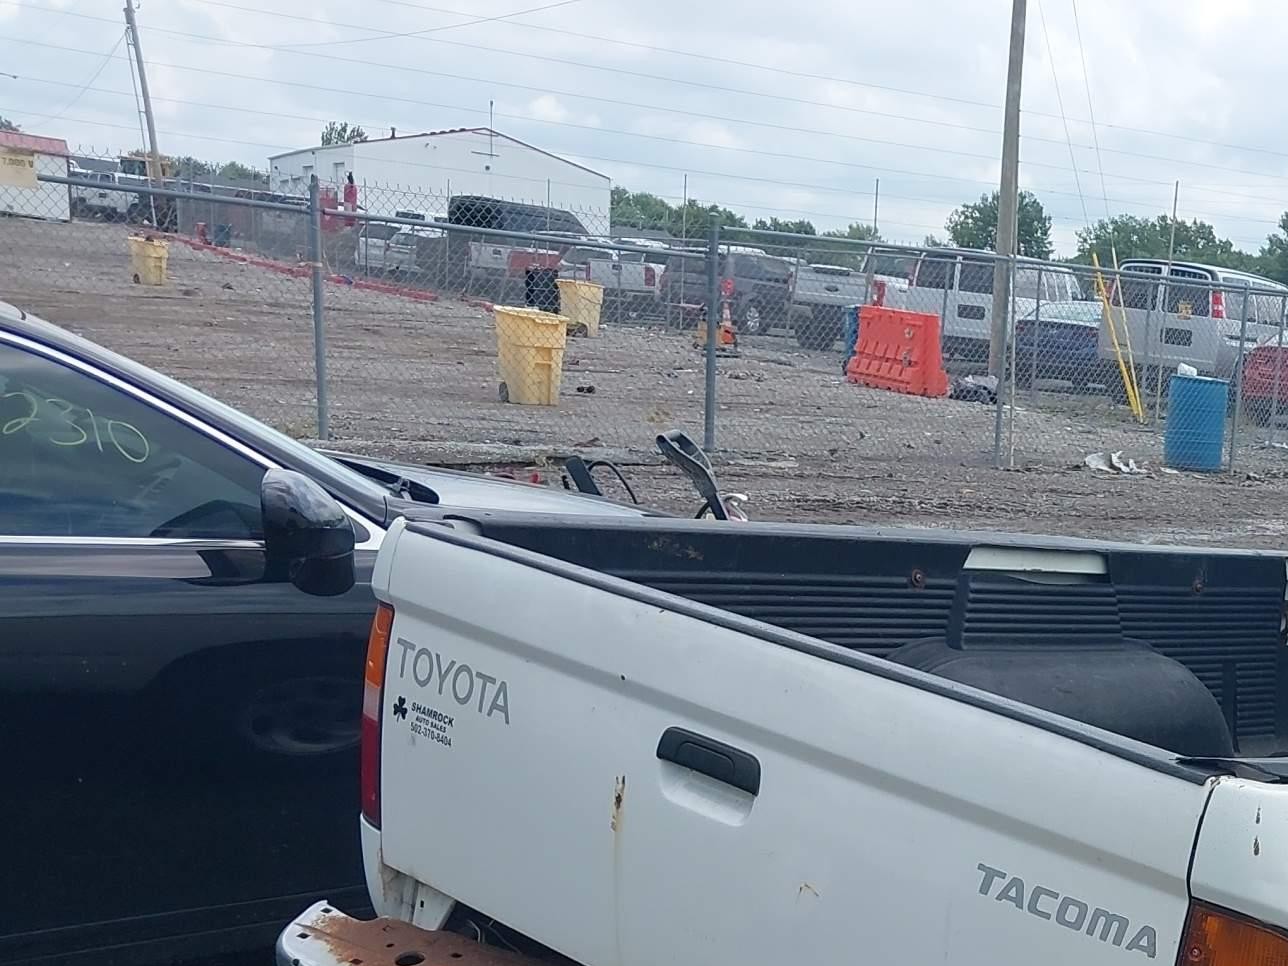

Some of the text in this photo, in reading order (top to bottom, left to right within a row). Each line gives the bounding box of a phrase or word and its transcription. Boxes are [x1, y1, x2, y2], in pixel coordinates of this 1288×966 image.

[2, 391, 149, 463] 2310
[396, 637, 509, 725] TOYOTA
[411, 702, 454, 728] SHAMROCK
[415, 715, 447, 734] AUTO SALES
[977, 862, 1157, 959] TACOMA
